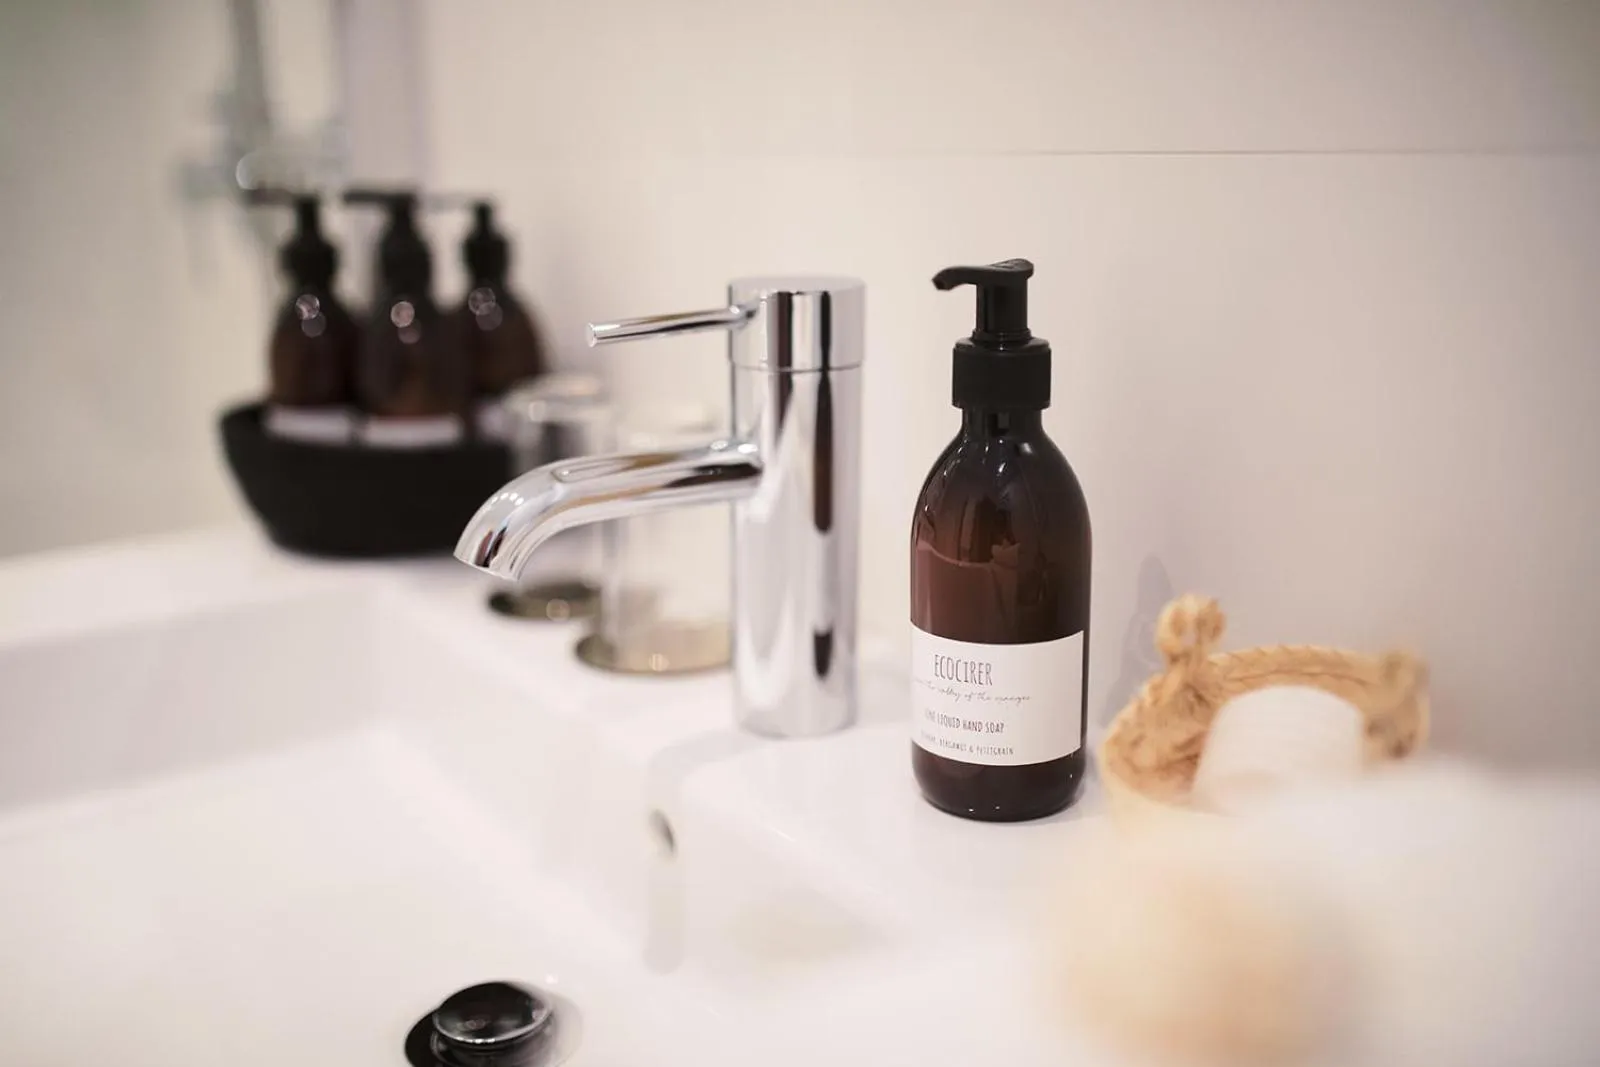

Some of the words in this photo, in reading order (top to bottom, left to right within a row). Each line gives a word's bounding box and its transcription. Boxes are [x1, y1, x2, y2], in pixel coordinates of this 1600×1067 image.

[934, 654, 993, 686] ECOCIRER
[937, 711, 960, 729] LIQUID
[962, 719, 983, 733] HAND
[985, 722, 1005, 734] SOAP
